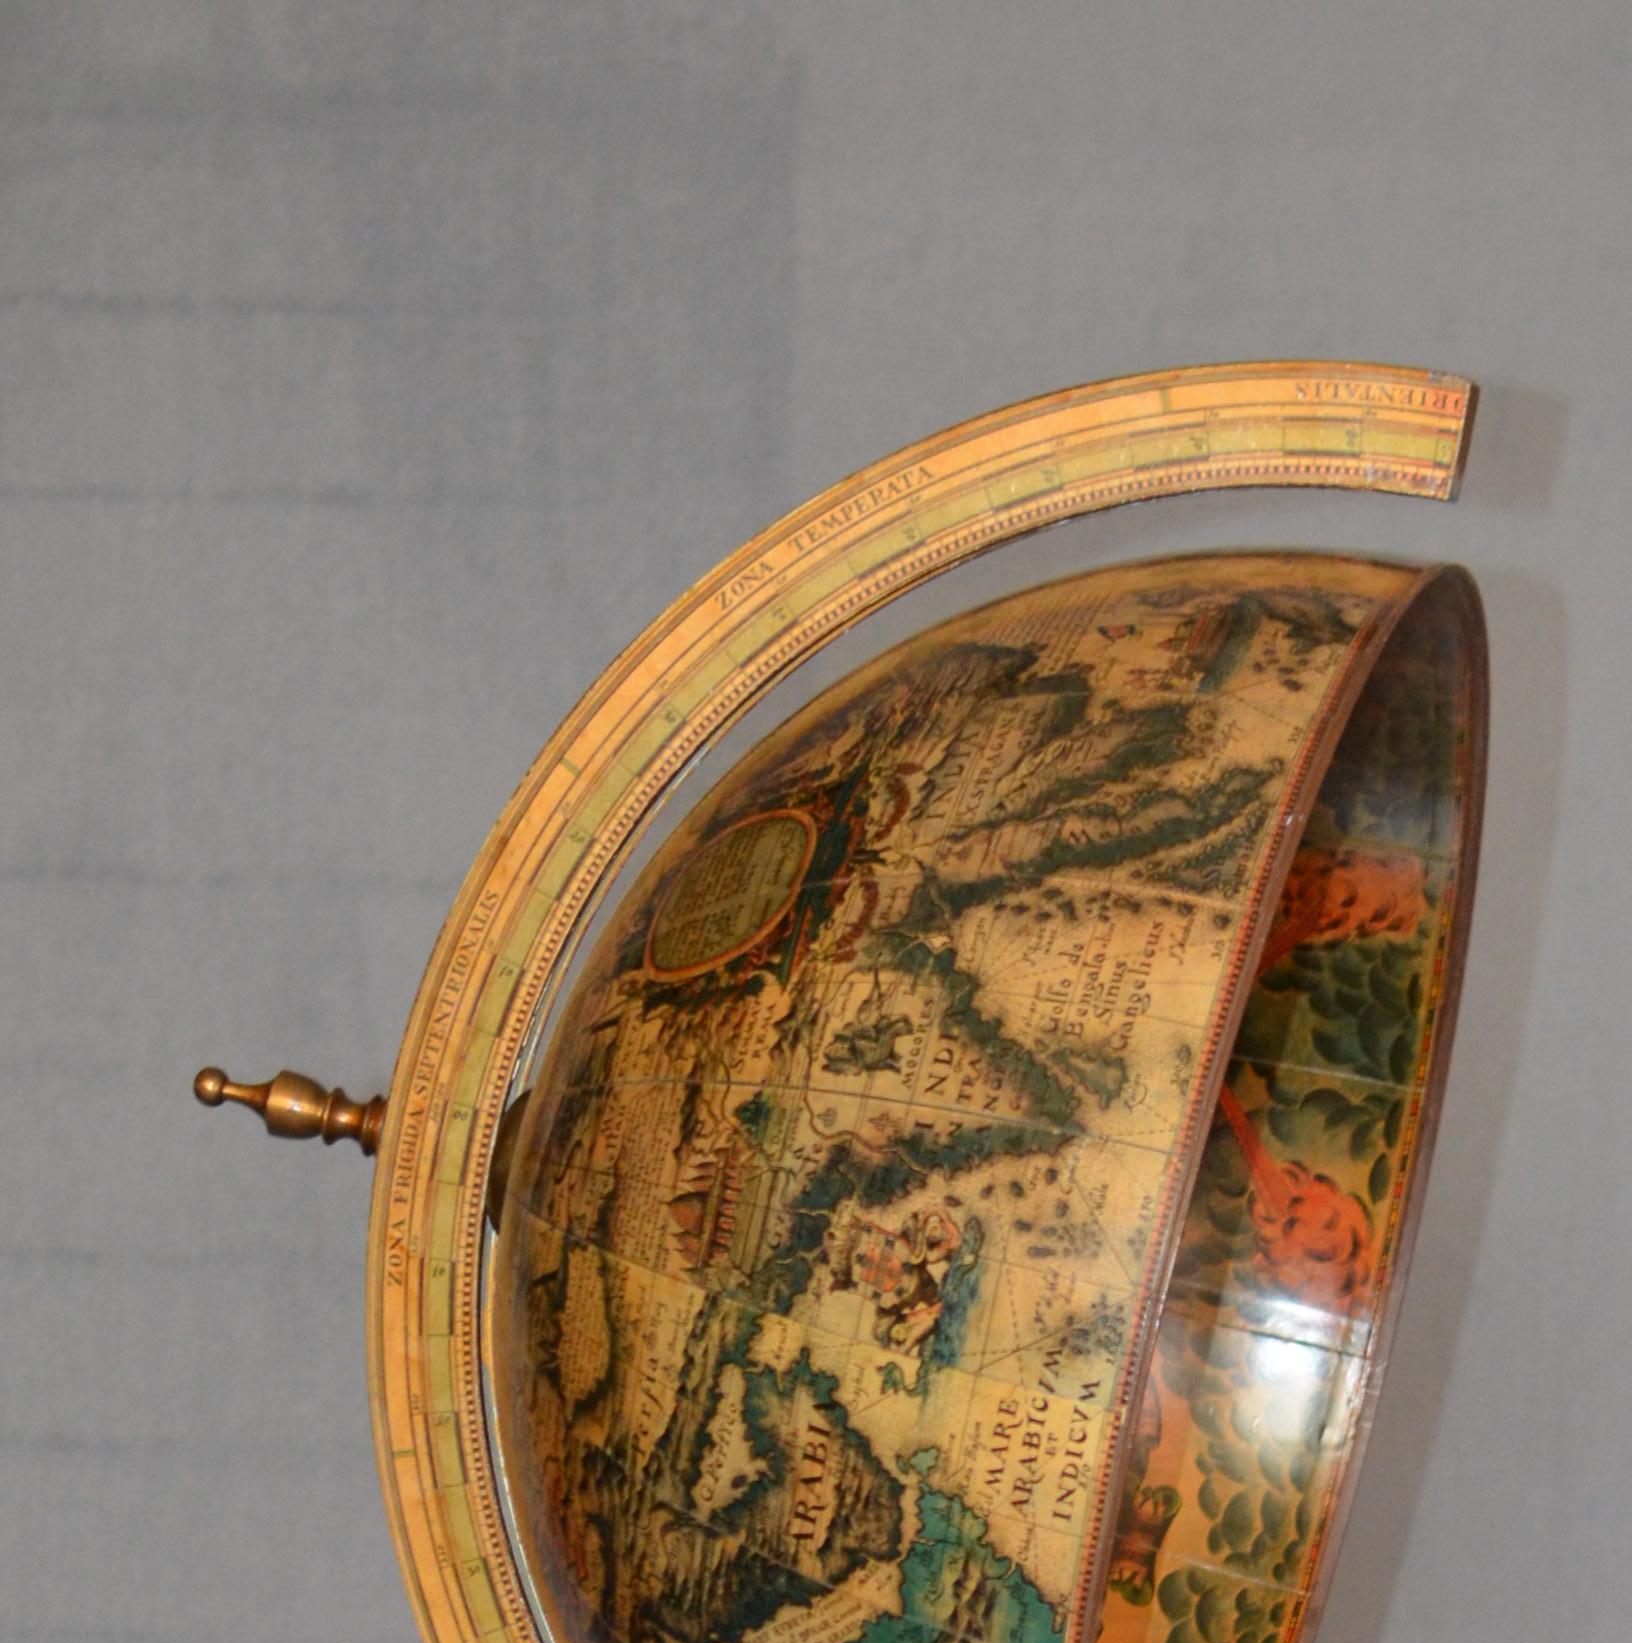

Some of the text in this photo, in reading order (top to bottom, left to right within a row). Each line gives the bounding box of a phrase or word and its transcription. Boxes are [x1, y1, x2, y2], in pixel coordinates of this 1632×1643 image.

[715, 560, 774, 611] ZONA
[1066, 941, 1108, 1041] Bengala
[1094, 960, 1127, 1025] Sinus
[388, 889, 500, 1287] ZONA FRIGIDA SEPTENTRIONALIS
[986, 1398, 1021, 1490] MARE
[1052, 1380, 1099, 1522] INDICVM
